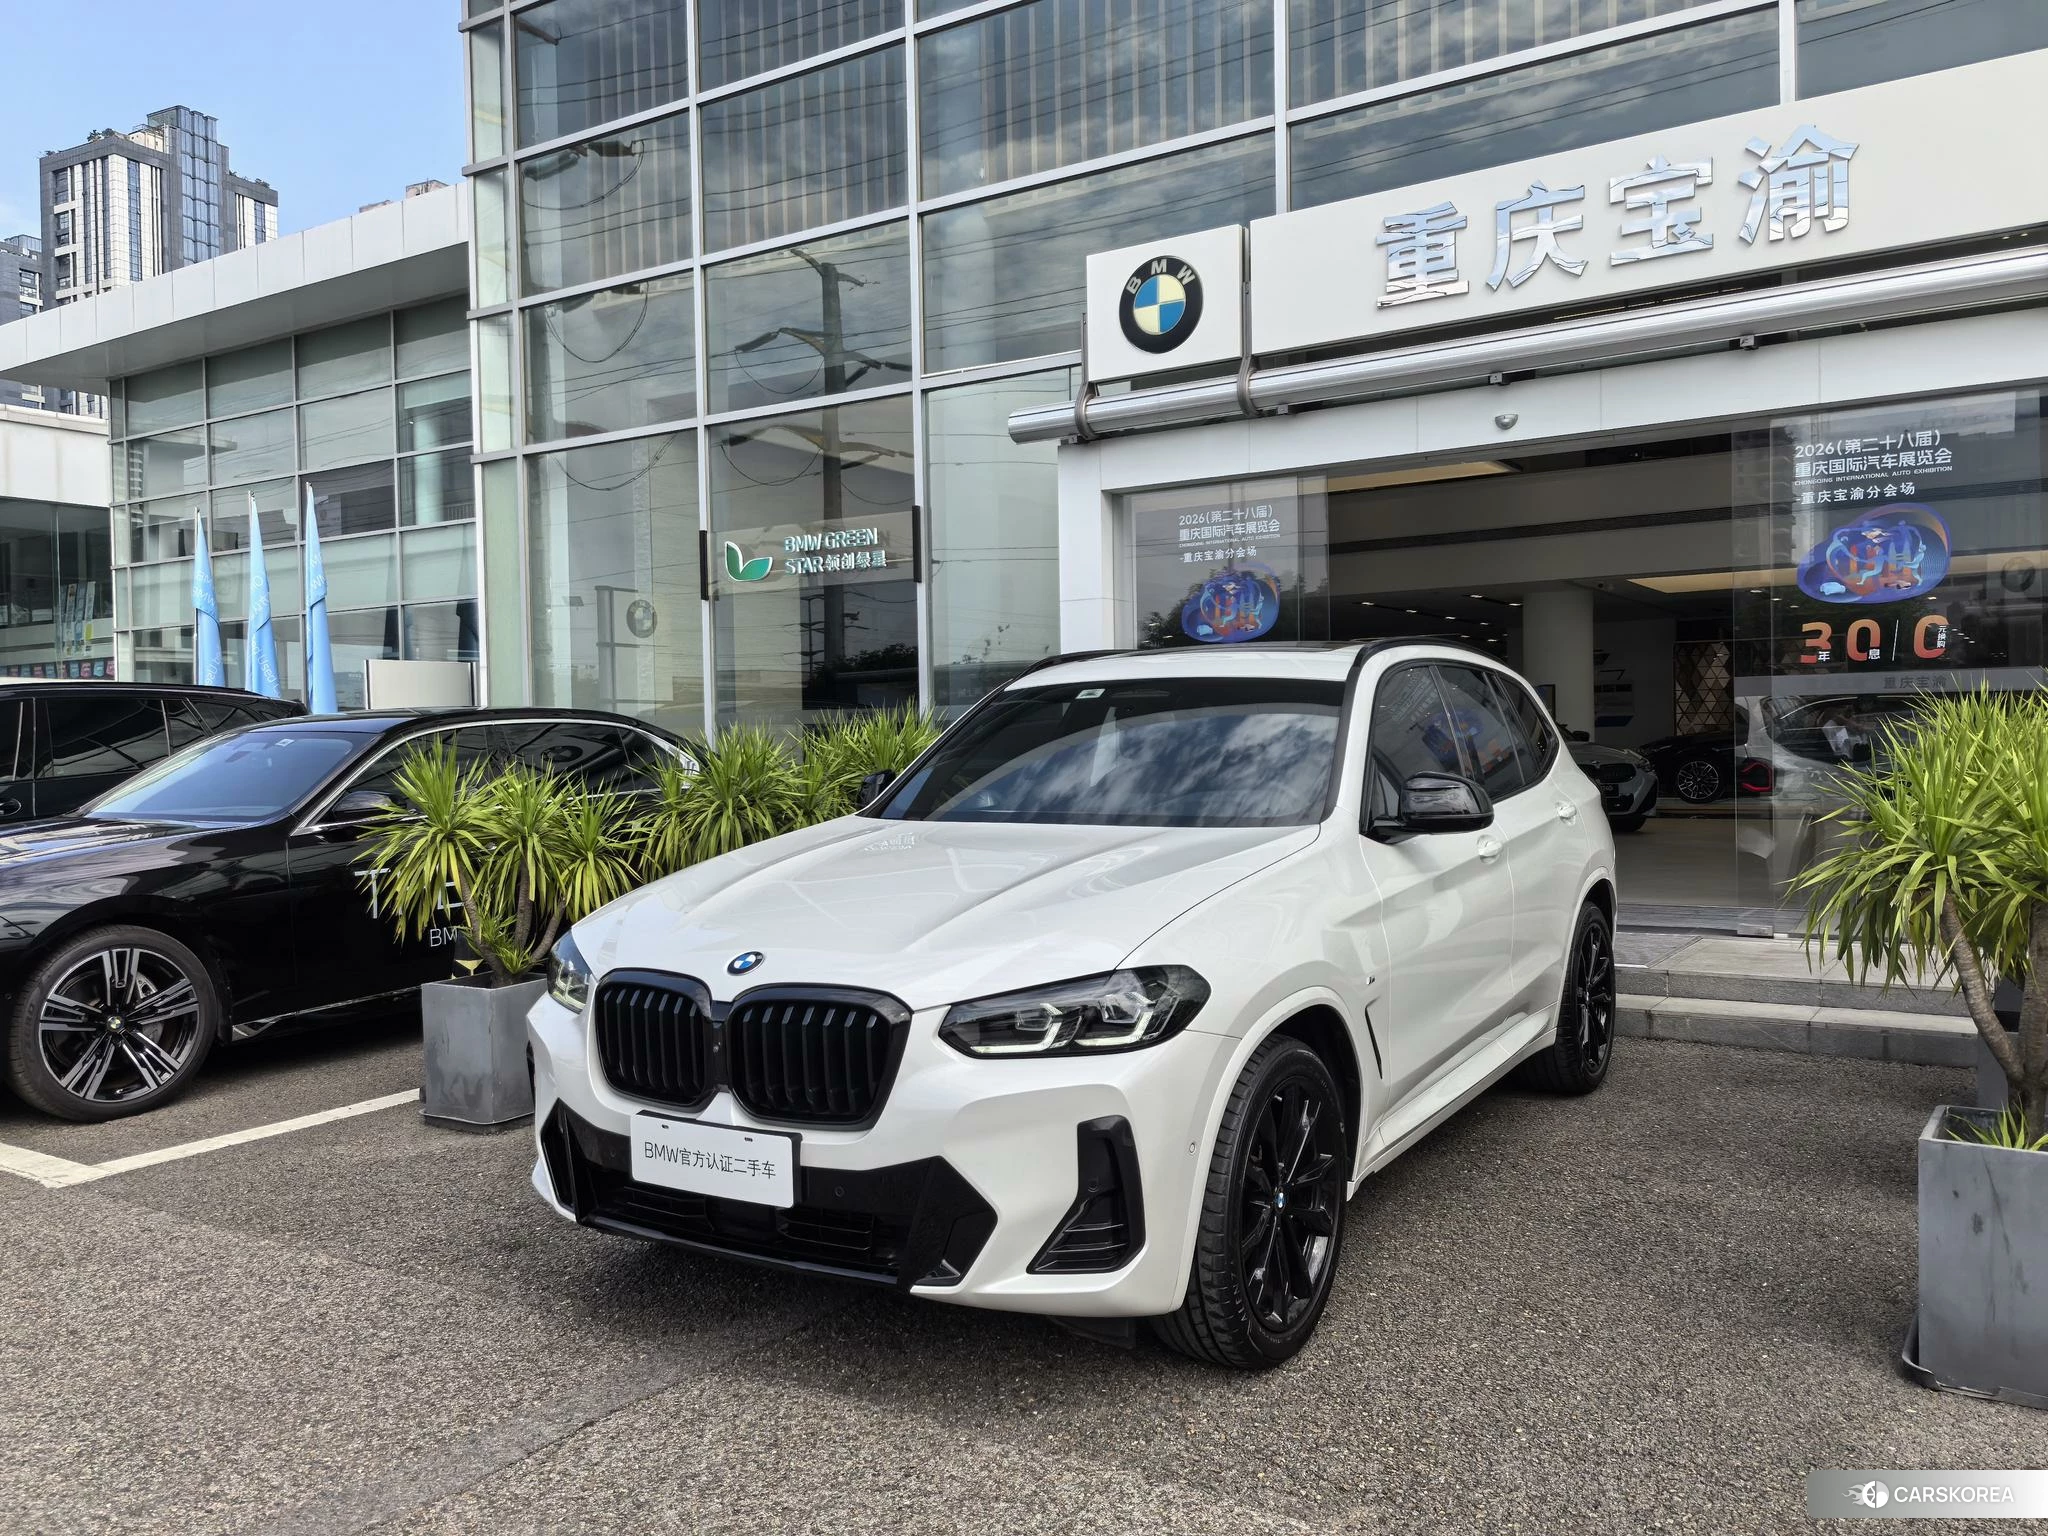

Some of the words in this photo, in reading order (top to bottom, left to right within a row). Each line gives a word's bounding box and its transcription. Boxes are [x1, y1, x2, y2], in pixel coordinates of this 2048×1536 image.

[1376, 124, 1859, 309] 重庆宝渝
[1125, 258, 1196, 295] BMW
[1795, 448, 1953, 478] 重庆国际汽车展览会
[1835, 472, 1889, 482] INTERNATIONAL
[1914, 466, 1953, 474] EXHIBITION
[784, 533, 822, 553] BMW
[824, 528, 878, 549] GREEN
[1179, 519, 1280, 541] 重庆国际汽车展览会
[430, 927, 458, 947] BM
[644, 1141, 777, 1179] BMW官方认证二手车
